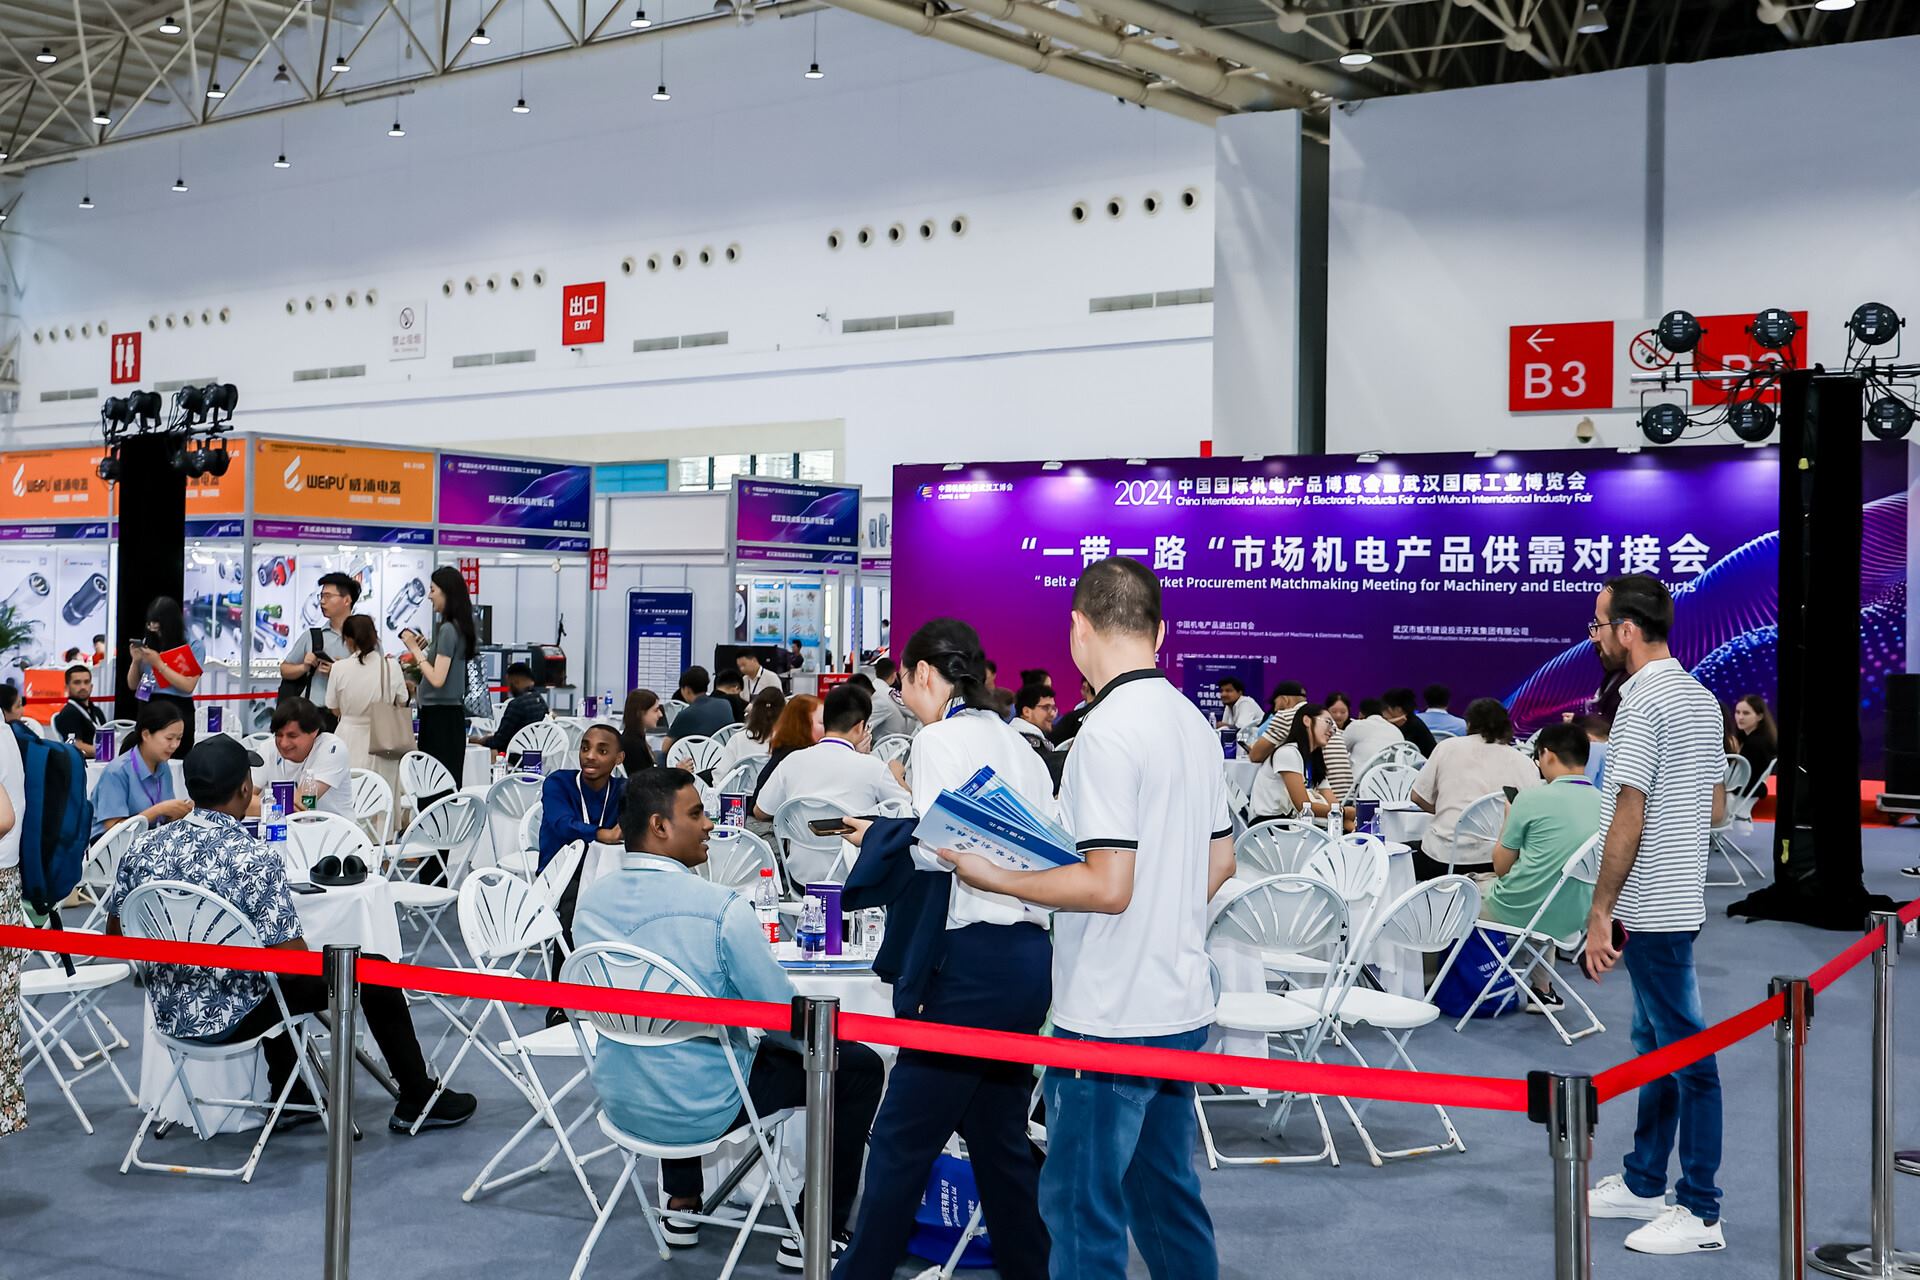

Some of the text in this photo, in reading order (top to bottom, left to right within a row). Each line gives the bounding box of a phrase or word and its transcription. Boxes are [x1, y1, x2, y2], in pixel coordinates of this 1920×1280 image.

[569, 295, 598, 316] 出口
[574, 320, 592, 331] EXIT
[1524, 361, 1587, 400] B3
[1114, 471, 1587, 506] 2024 中国国际机电产品博览会暨武汉国际工业博览会
[1176, 492, 1593, 507] China International Machinery & Electronic Products Fair and Wuhan International Industry Fair
[1044, 576, 1067, 587] Belt
[1159, 577, 1184, 588] rket
[1186, 577, 1267, 589] Procurement
[1270, 577, 1359, 592] Matchmaking
[1362, 578, 1417, 593] Meeting
[1420, 579, 1440, 591] for
[1443, 579, 1517, 594] Machinery
[1520, 580, 1549, 592] and
[1553, 580, 1603, 592] Electro
[1665, 580, 1697, 593] ucts
[1176, 620, 1256, 630] 中国机电产品进出口商会
